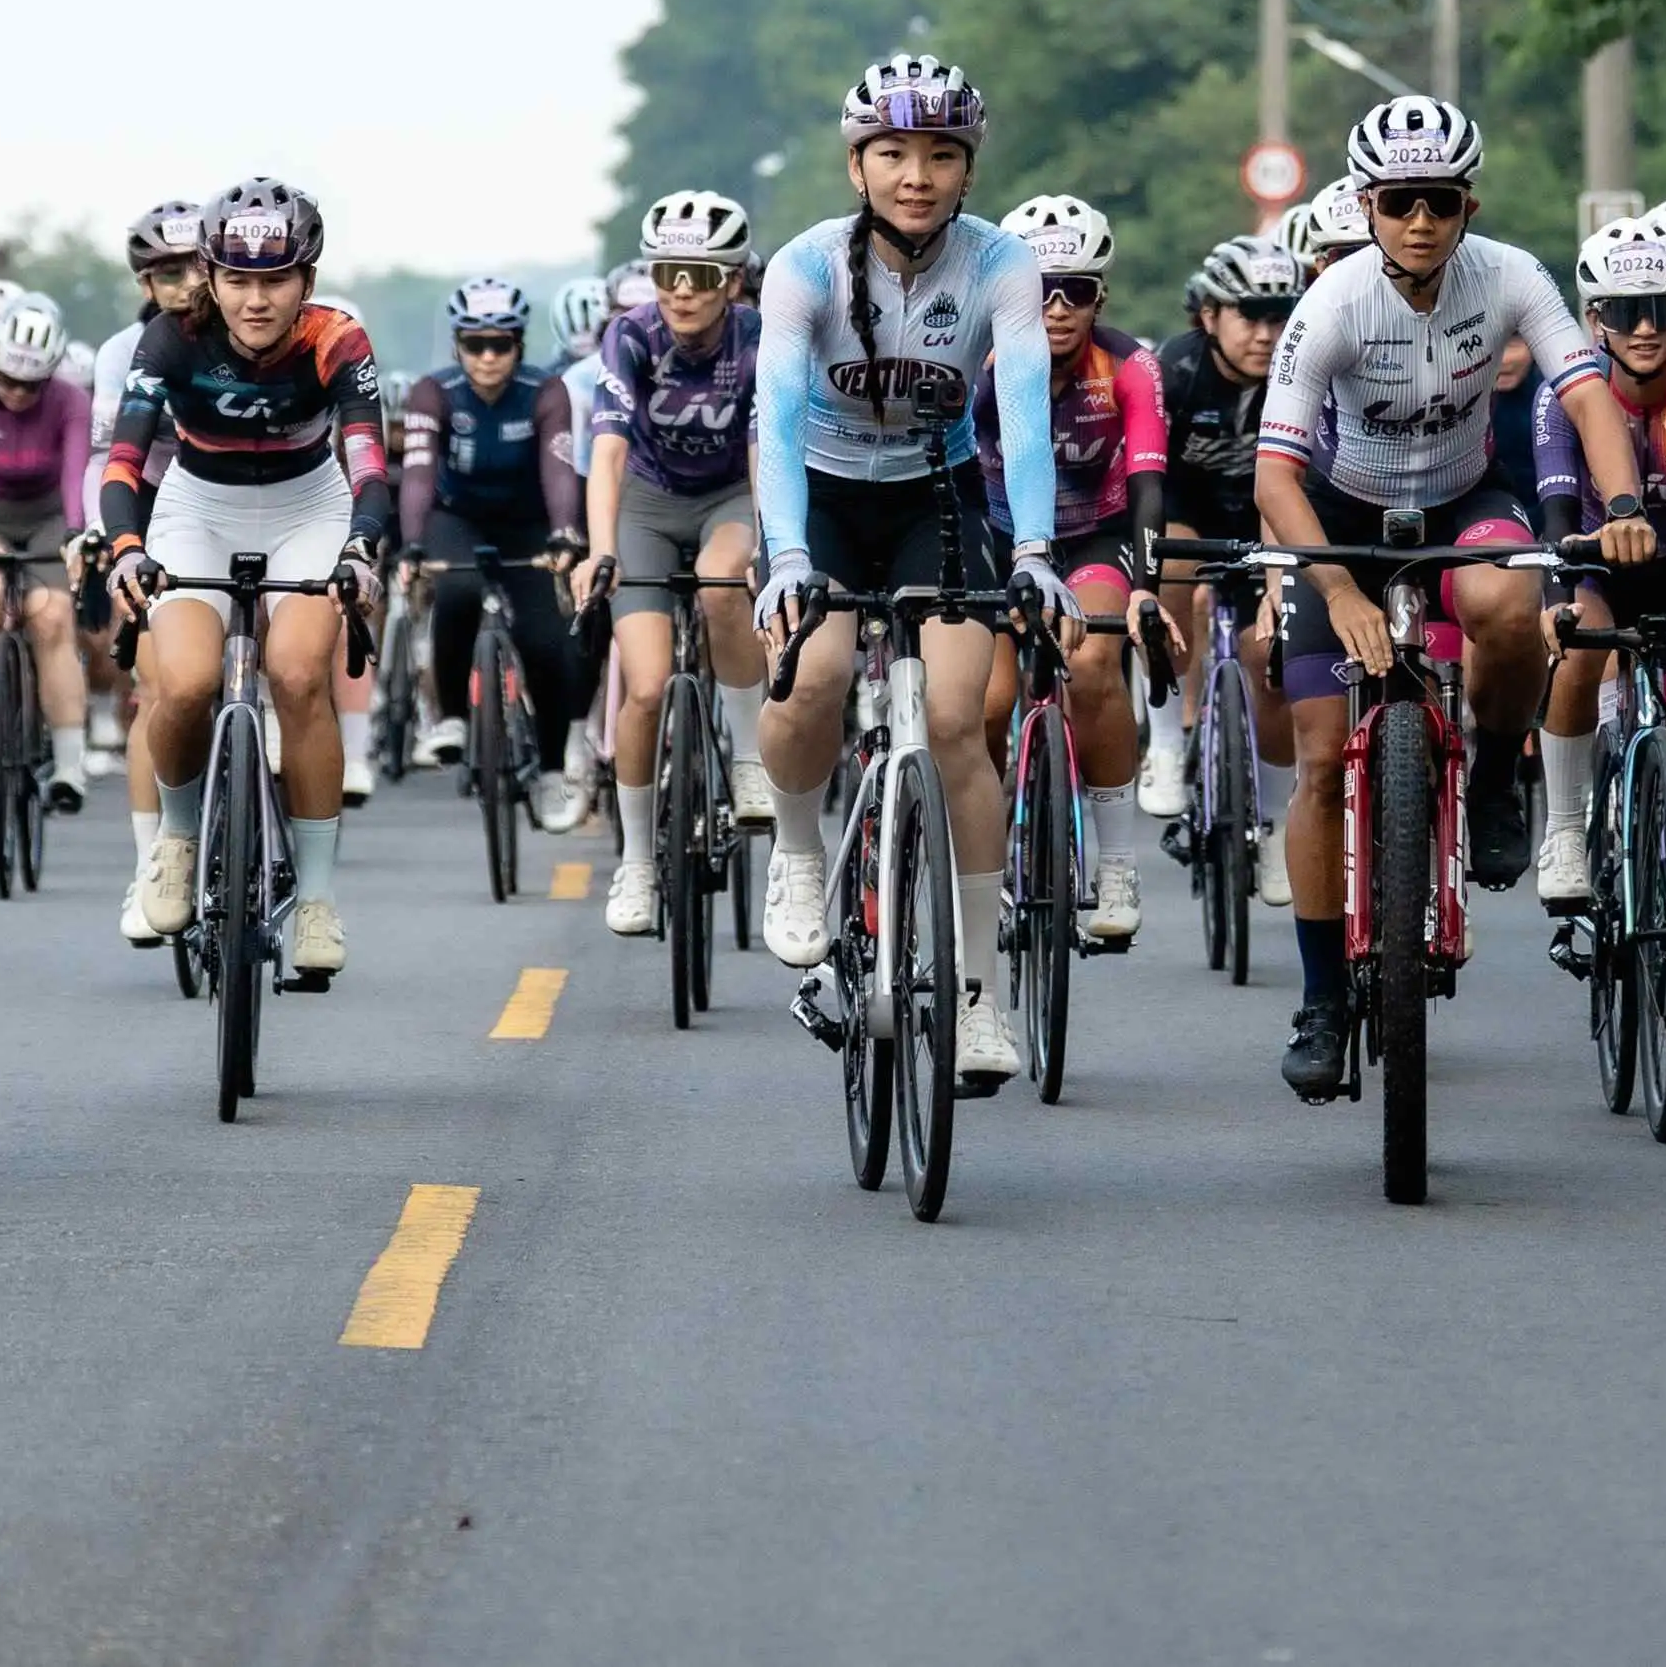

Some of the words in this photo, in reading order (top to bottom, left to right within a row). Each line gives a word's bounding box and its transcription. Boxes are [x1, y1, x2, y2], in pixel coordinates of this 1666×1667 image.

[1388, 147, 1445, 163] 20221
[1336, 202, 1361, 216] 202
[229, 224, 283, 240] 21020
[1030, 241, 1077, 257] 20222
[1612, 256, 1664, 274] 20224
[1443, 311, 1485, 338] VERGE
[923, 333, 956, 347] Liv
[1564, 347, 1595, 363] SR
[649, 390, 736, 430] Liv
[1261, 421, 1308, 438] RAM
[1133, 452, 1167, 464] SRA
